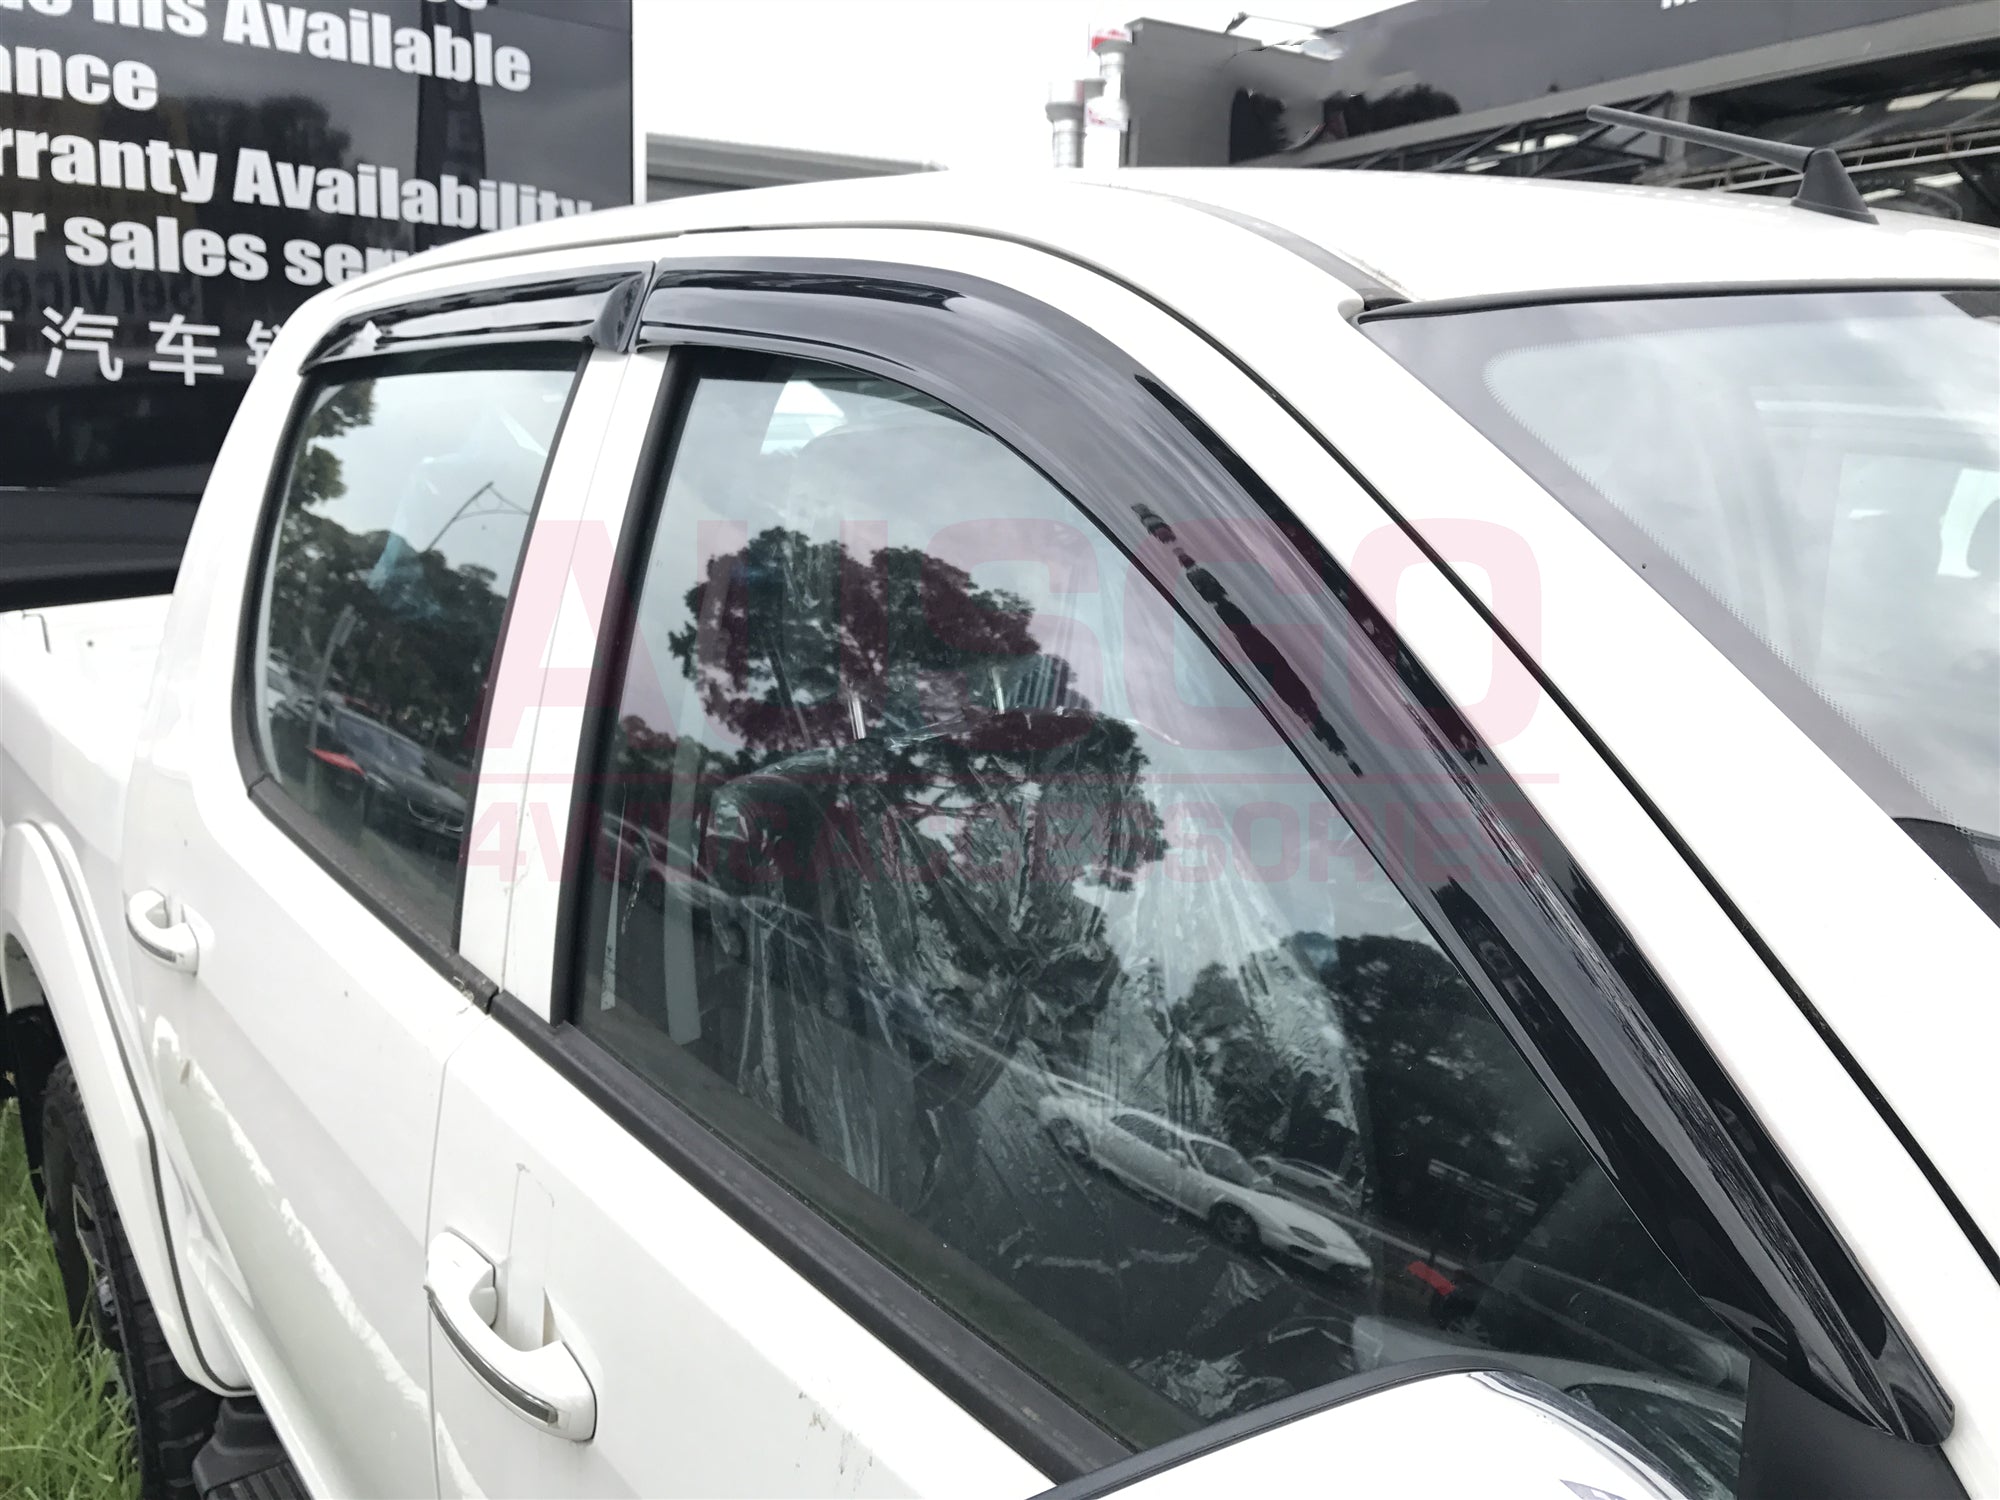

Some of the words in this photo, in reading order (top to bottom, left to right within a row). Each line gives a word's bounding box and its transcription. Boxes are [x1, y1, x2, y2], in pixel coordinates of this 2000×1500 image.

[0, 44, 159, 111] nce
[223, 0, 531, 92] Available
[0, 210, 47, 261] r
[63, 215, 269, 281] sales
